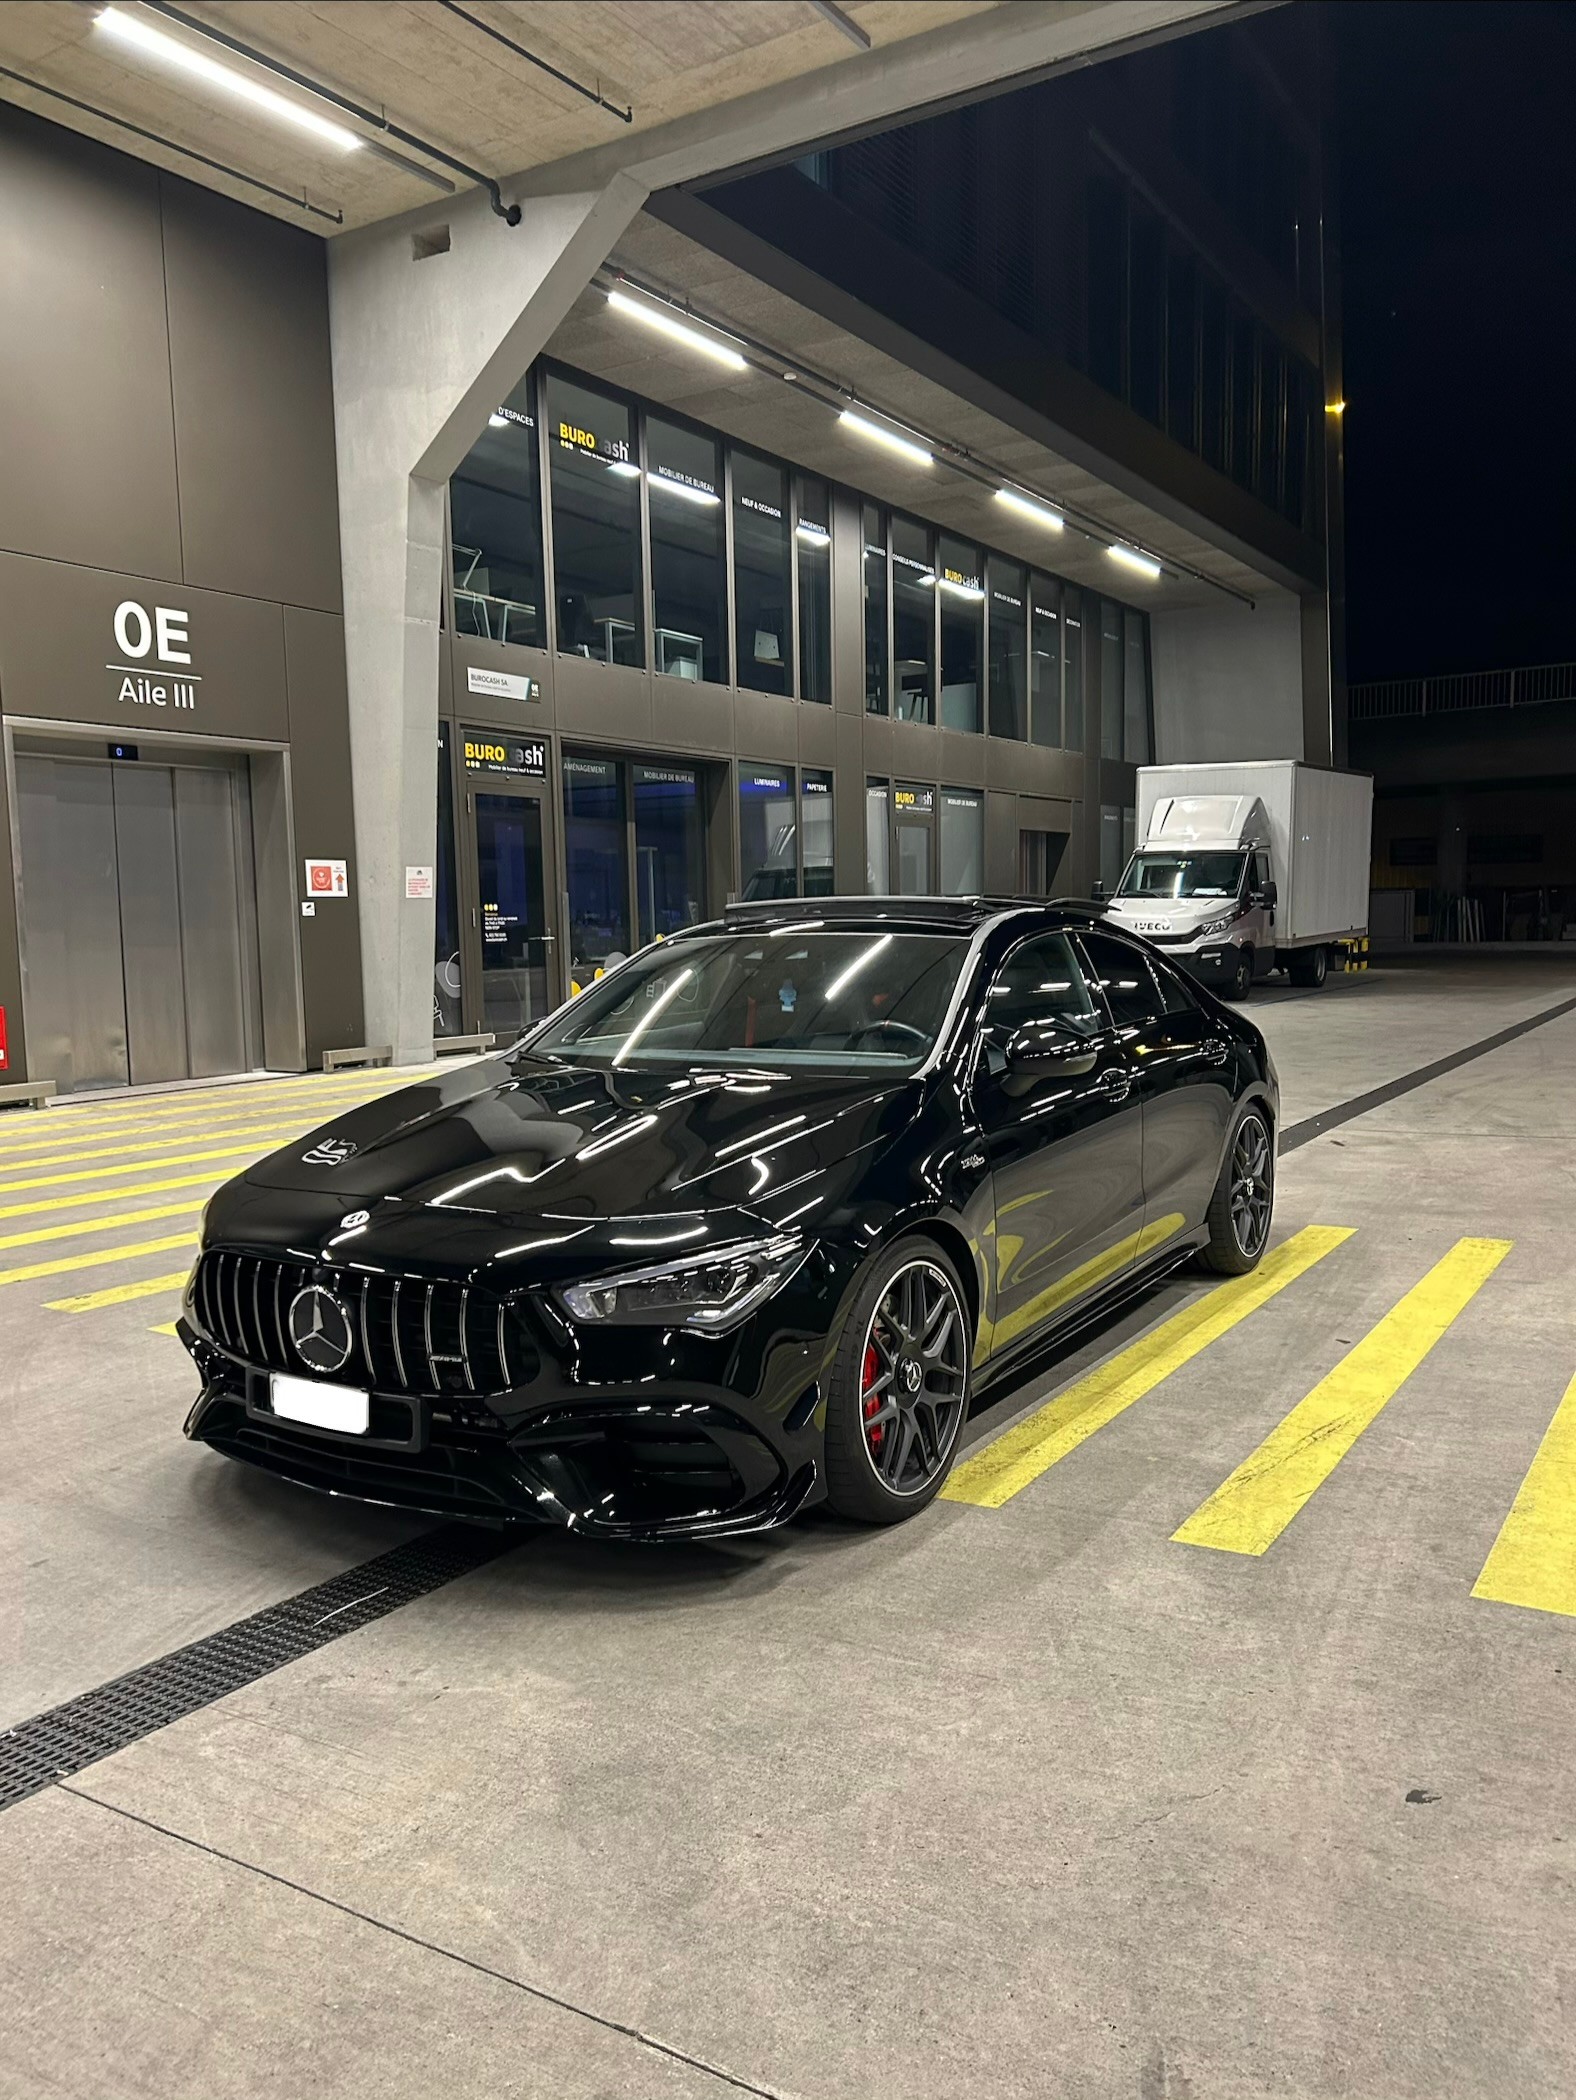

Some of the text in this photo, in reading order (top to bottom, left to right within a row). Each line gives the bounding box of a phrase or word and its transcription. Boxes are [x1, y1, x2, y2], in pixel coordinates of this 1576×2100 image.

[498, 406, 534, 427] D'ESPACES
[560, 422, 629, 461] BURO ash
[658, 466, 714, 493] MOBILIER DE BUREAU
[741, 496, 753, 508] NEUF
[759, 501, 781, 518] OCCASION
[944, 568, 962, 583] BURO
[114, 601, 191, 664] OE
[470, 674, 500, 684] BUROCASH
[118, 677, 194, 709] Aile III
[464, 742, 544, 766] BURO ash
[563, 762, 605, 774] AMÉNAGEMENT
[643, 771, 694, 783] MOBILIER DE BUREAU
[806, 783, 827, 792] PAPETERIE
[895, 792, 914, 804] BURO
